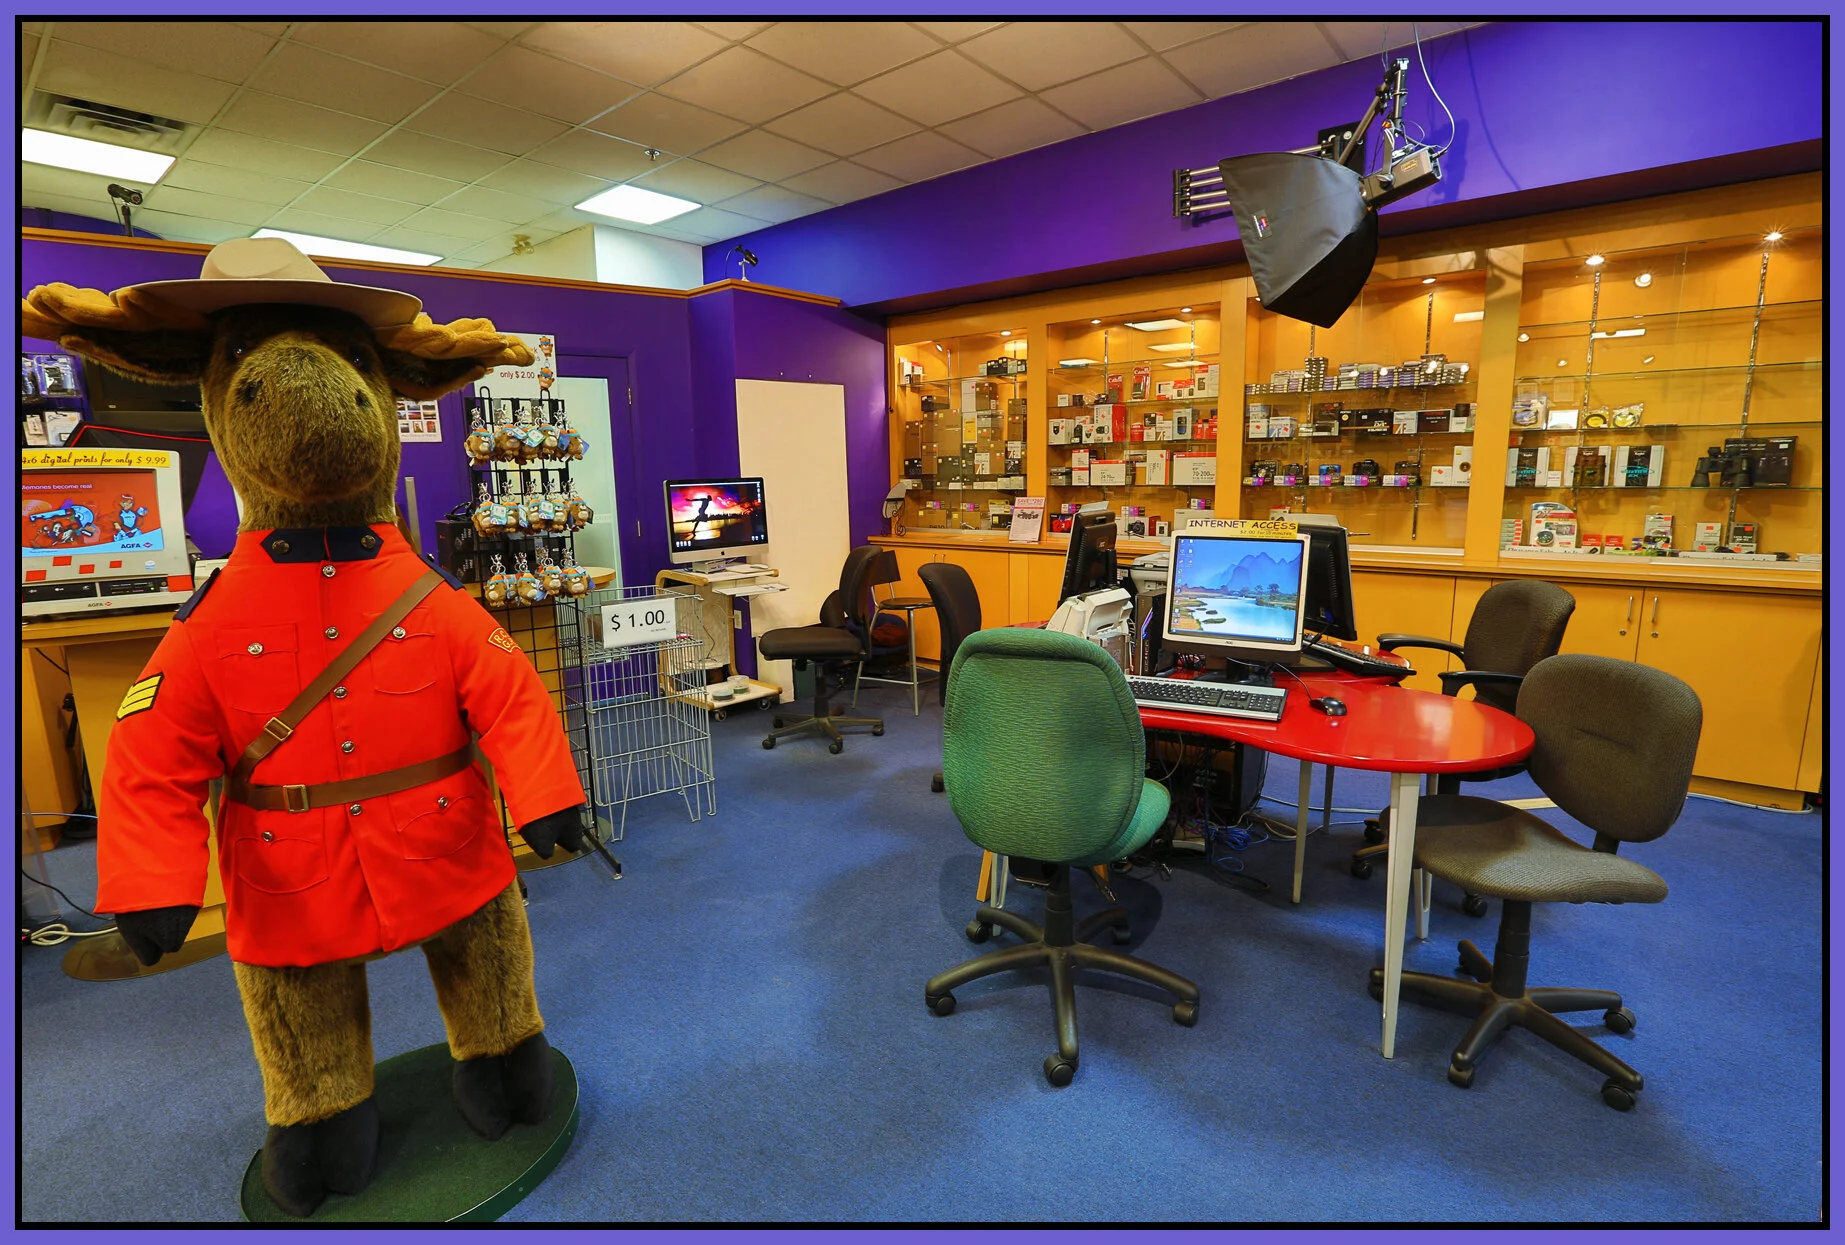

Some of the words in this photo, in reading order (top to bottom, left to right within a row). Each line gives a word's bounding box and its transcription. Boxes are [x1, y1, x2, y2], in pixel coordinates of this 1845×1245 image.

[500, 370, 514, 379] only
[515, 370, 520, 378] $
[520, 371, 535, 379] 2.00
[40, 452, 72, 467] digital
[73, 455, 98, 466] prints
[100, 451, 113, 466] for
[115, 454, 133, 466] only
[136, 456, 143, 464] $
[1189, 520, 1247, 529] INTERNET
[1251, 521, 1297, 530] ACCESS
[611, 614, 621, 632] $
[629, 610, 665, 627] 1.00
